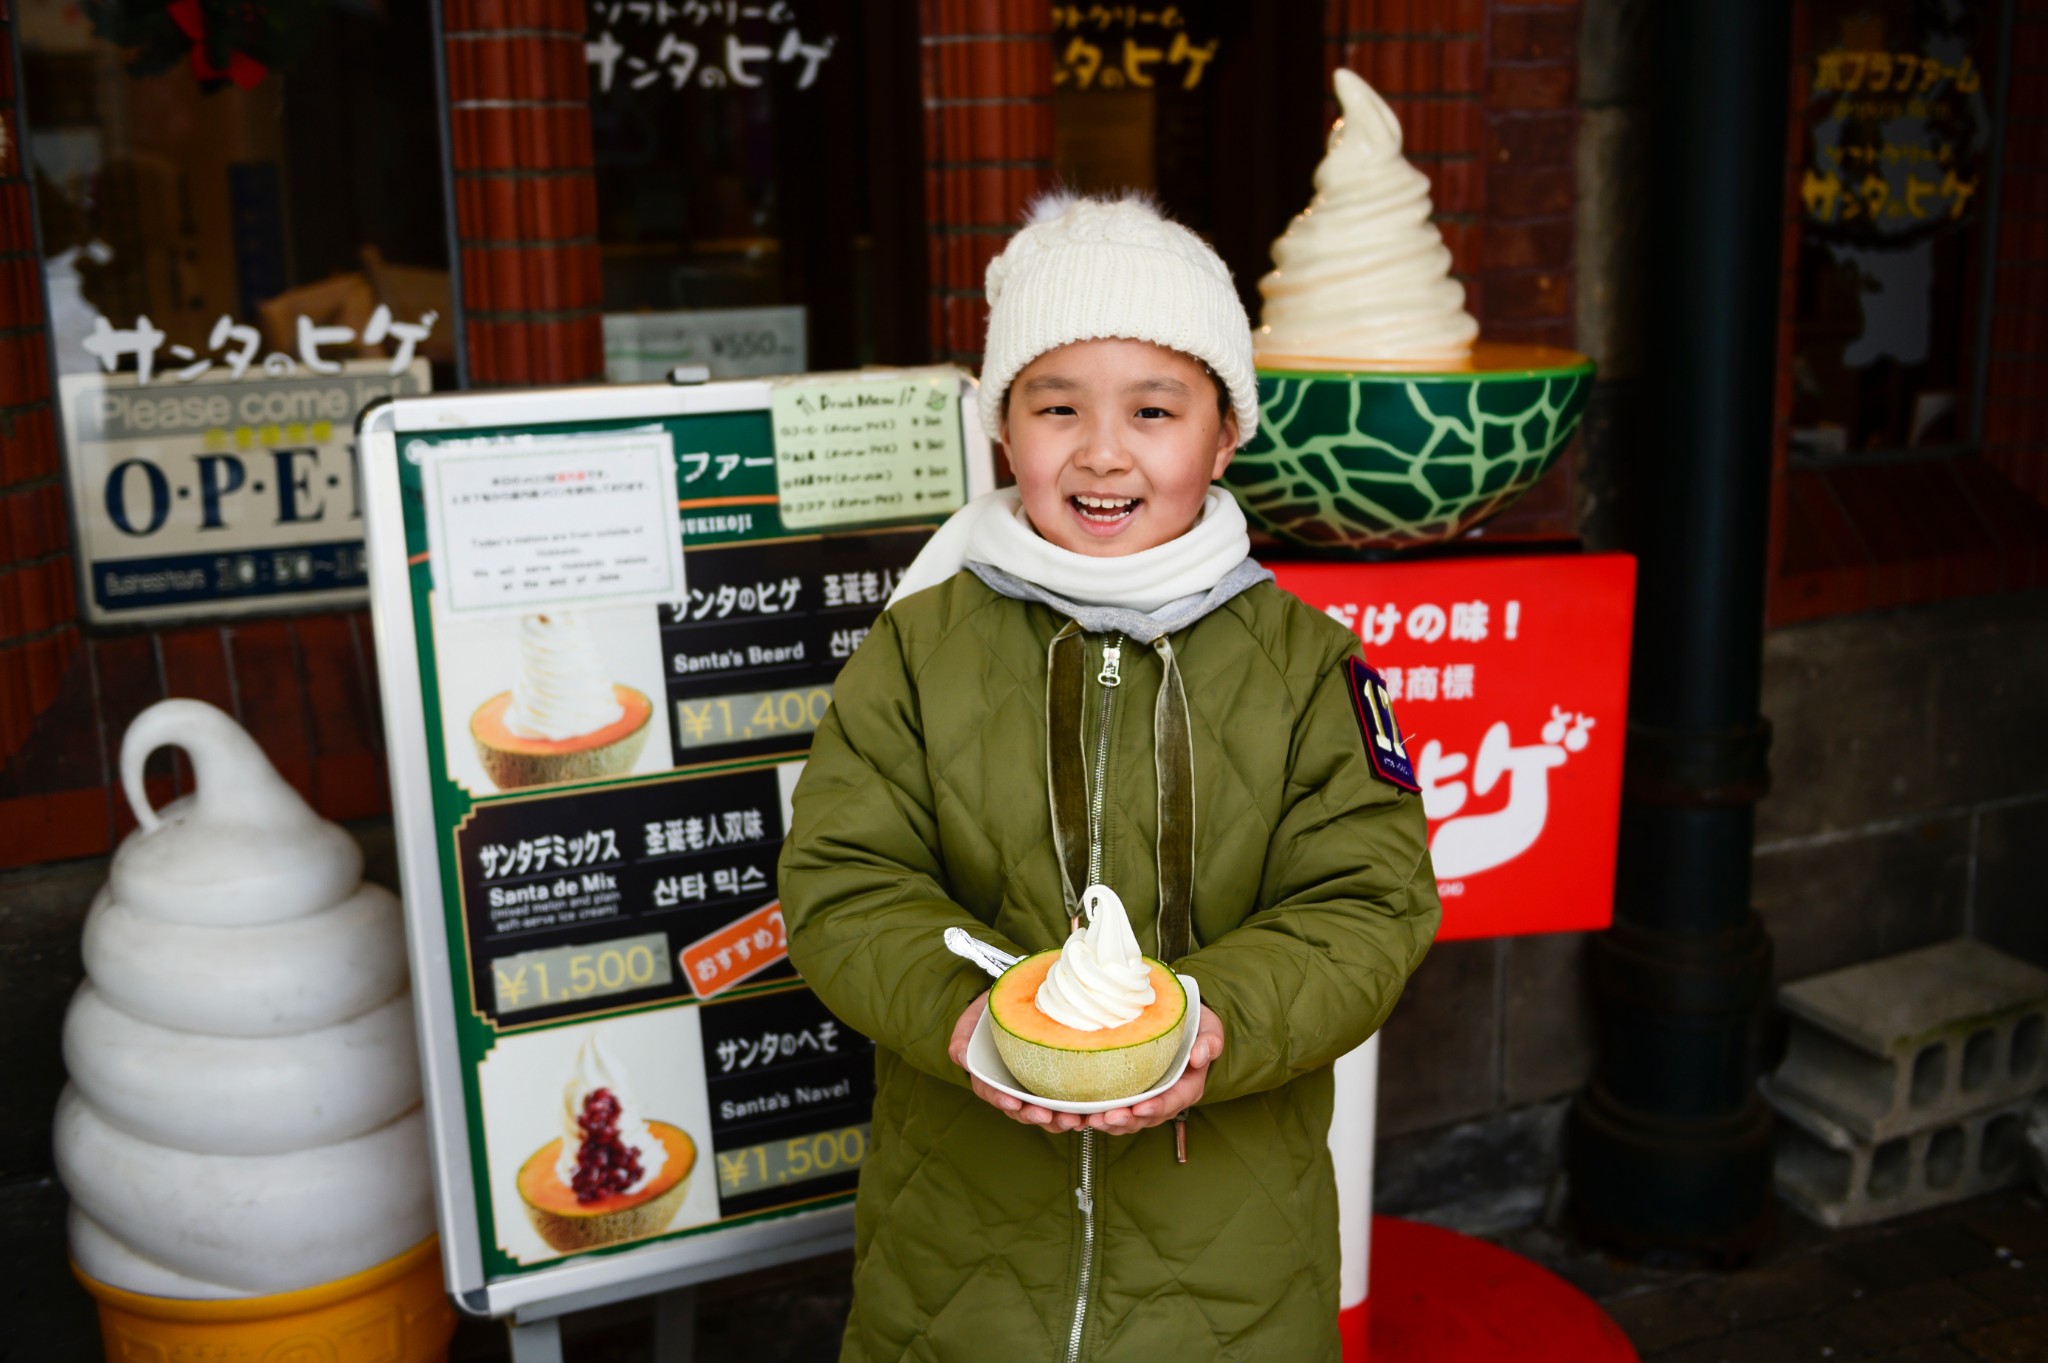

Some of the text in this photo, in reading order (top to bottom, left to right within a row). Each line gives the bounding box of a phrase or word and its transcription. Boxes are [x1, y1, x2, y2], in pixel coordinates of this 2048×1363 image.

[1801, 168, 1981, 222] サンタのヒゲ
[83, 304, 439, 385] サンタのヒゲ
[97, 391, 231, 431] Please
[239, 385, 349, 423] come
[673, 577, 802, 623] サンタのヒゲ
[823, 567, 908, 607] 圣诞老人
[674, 641, 805, 674] Santa's Beard
[681, 687, 832, 741] ¥1,400
[479, 828, 622, 880] サンタデミックス
[489, 871, 617, 909] Santa de Mix
[490, 903, 530, 921] (mixed
[569, 895, 592, 909] and
[653, 864, 768, 908] 산타 믹스
[558, 910, 577, 921] ice
[579, 903, 619, 919] cream)
[497, 945, 656, 1006] ¥1,500
[717, 1021, 839, 1073] サンタのへそ
[721, 1079, 850, 1120] Santa's Navel
[719, 1127, 865, 1188] ¥1,500
